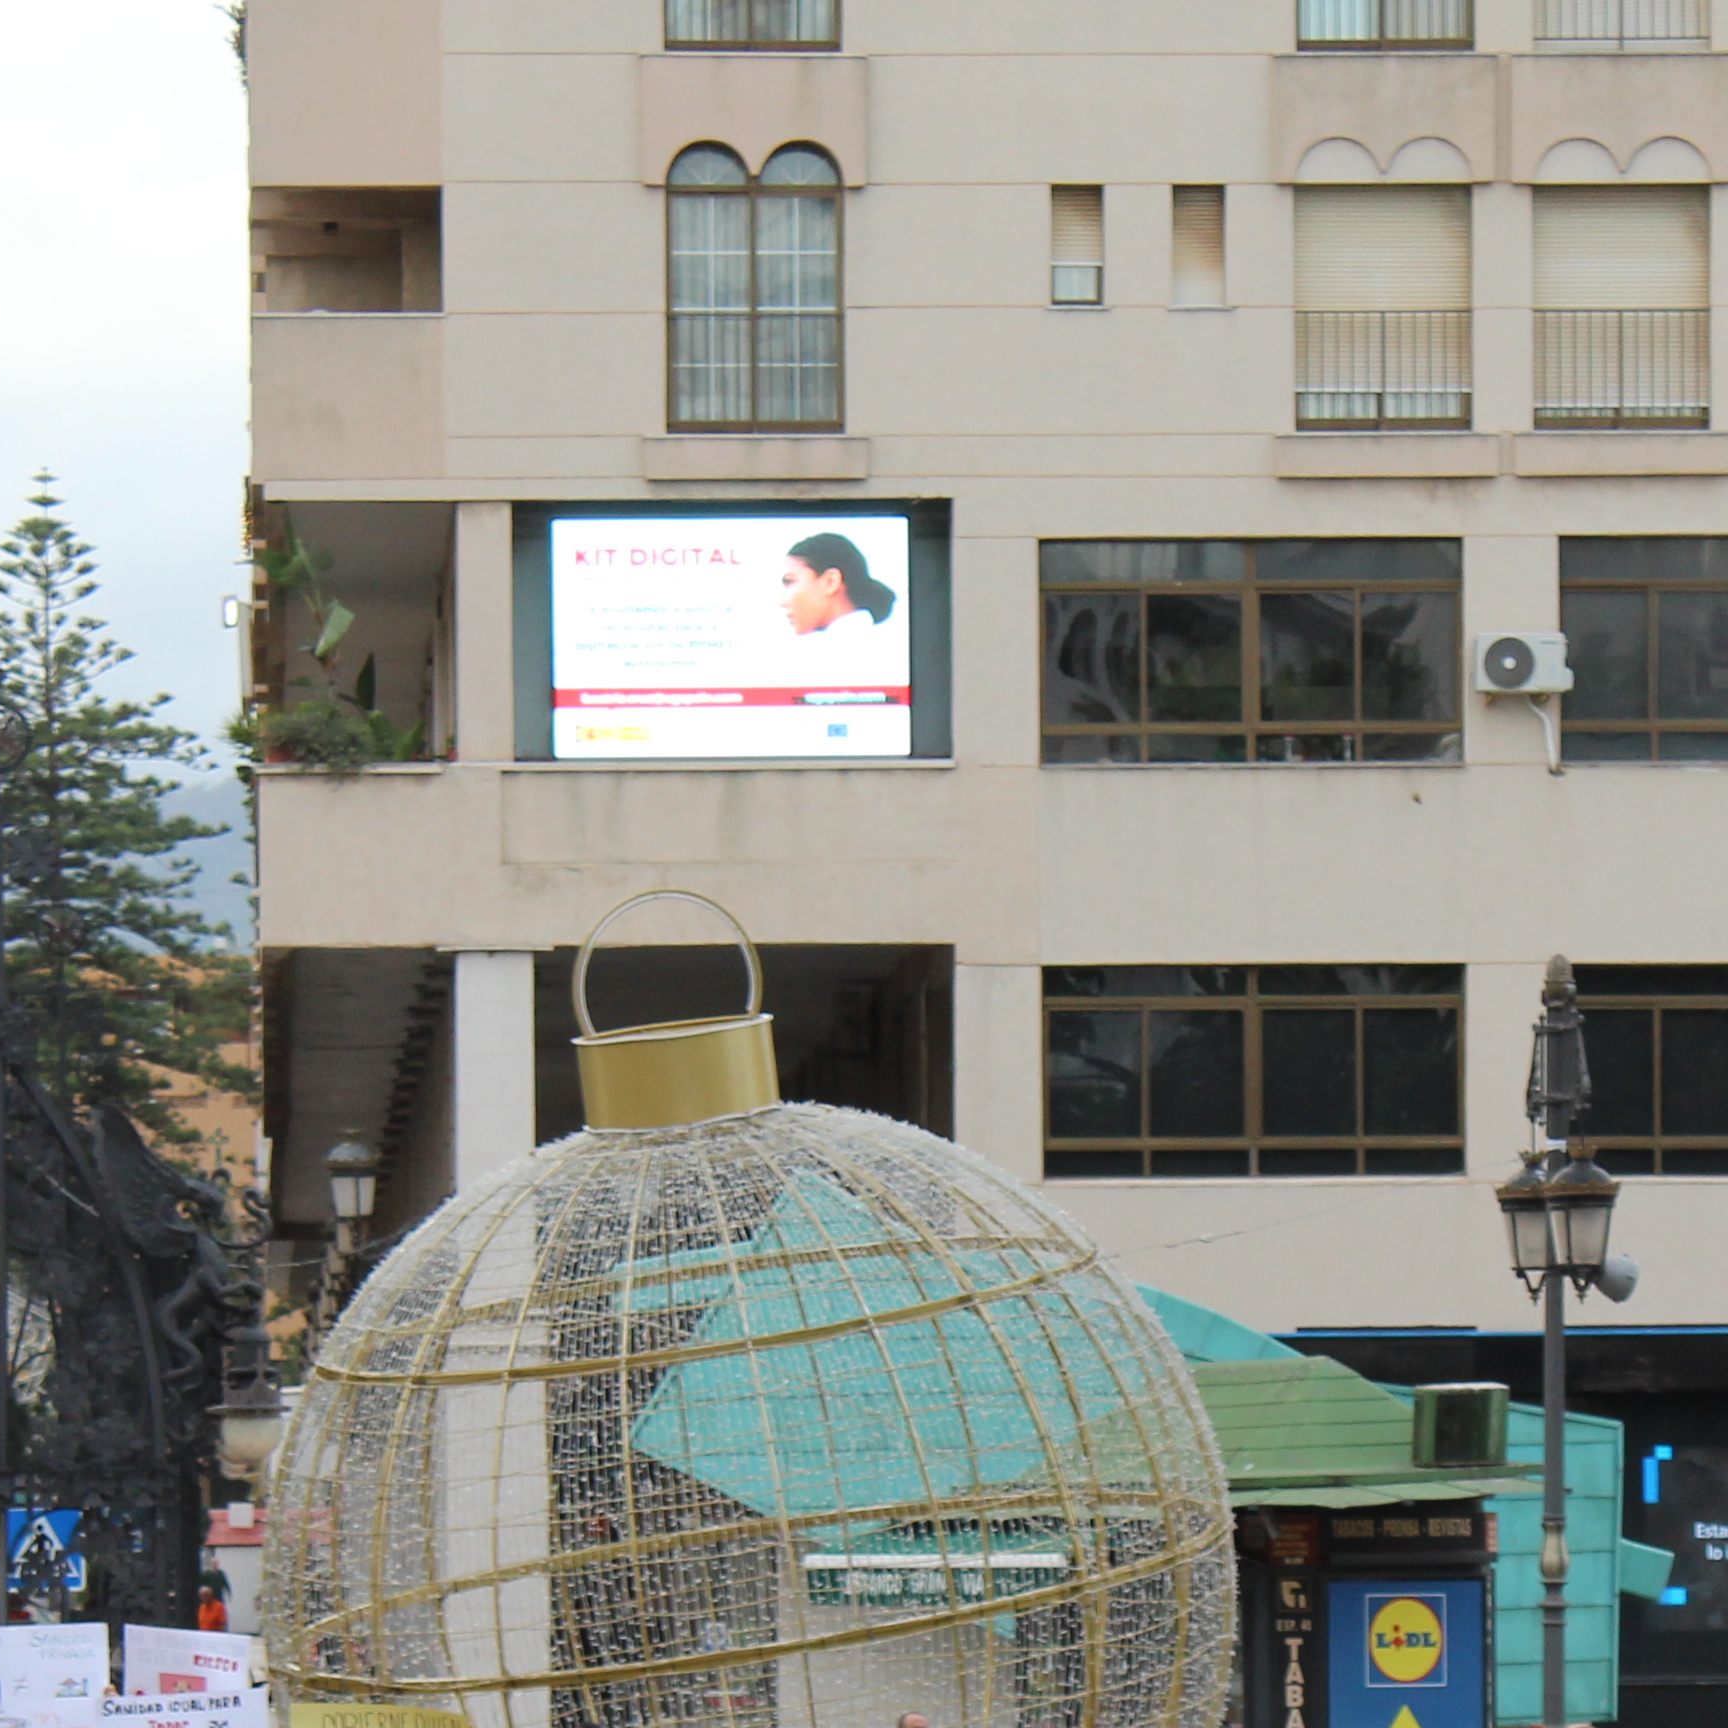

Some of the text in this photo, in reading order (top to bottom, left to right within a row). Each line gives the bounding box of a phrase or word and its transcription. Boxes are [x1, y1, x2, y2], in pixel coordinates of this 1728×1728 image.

[575, 547, 742, 566] KIT DIGITAL
[1705, 1543, 1724, 1561] lo
[1375, 1624, 1437, 1653] LIDL
